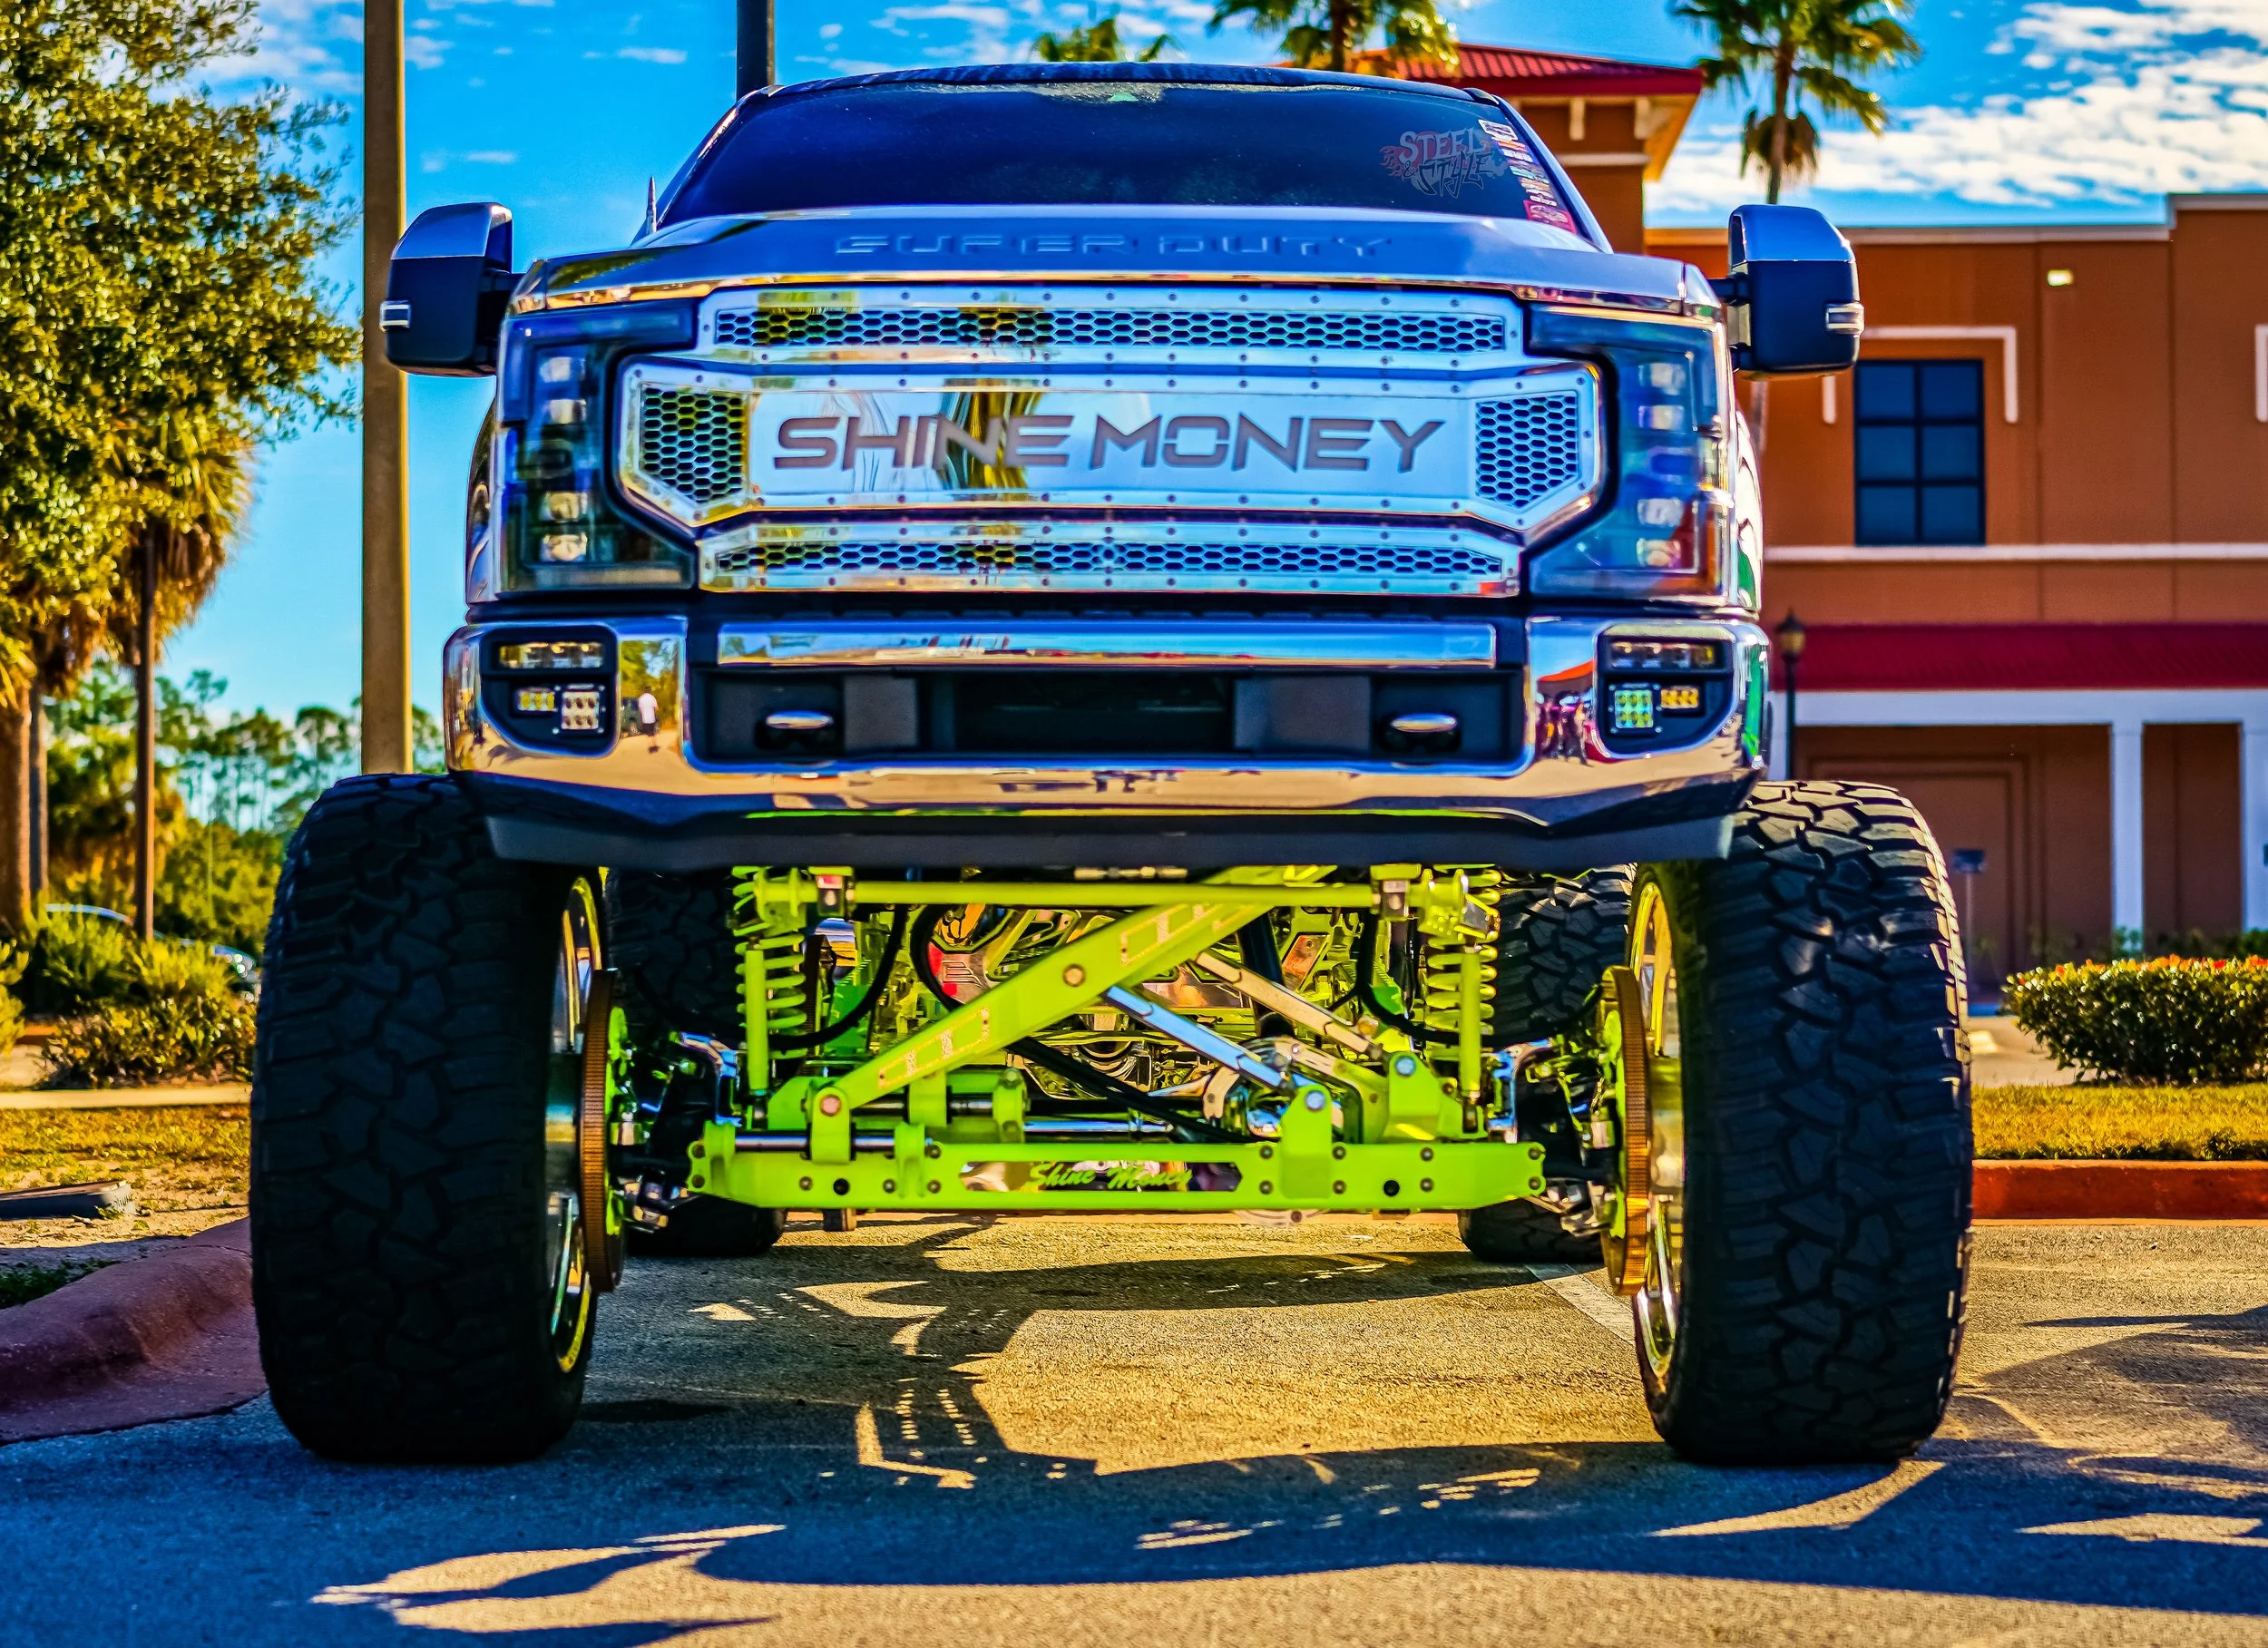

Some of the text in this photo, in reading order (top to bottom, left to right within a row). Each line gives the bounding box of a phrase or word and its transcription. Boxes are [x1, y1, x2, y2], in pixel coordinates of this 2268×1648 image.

[1398, 127, 1486, 163] STEEL
[1416, 151, 1495, 198] STYLE
[834, 234, 1393, 258] SUPER DUTY
[772, 414, 1445, 473] SHINE MONEY
